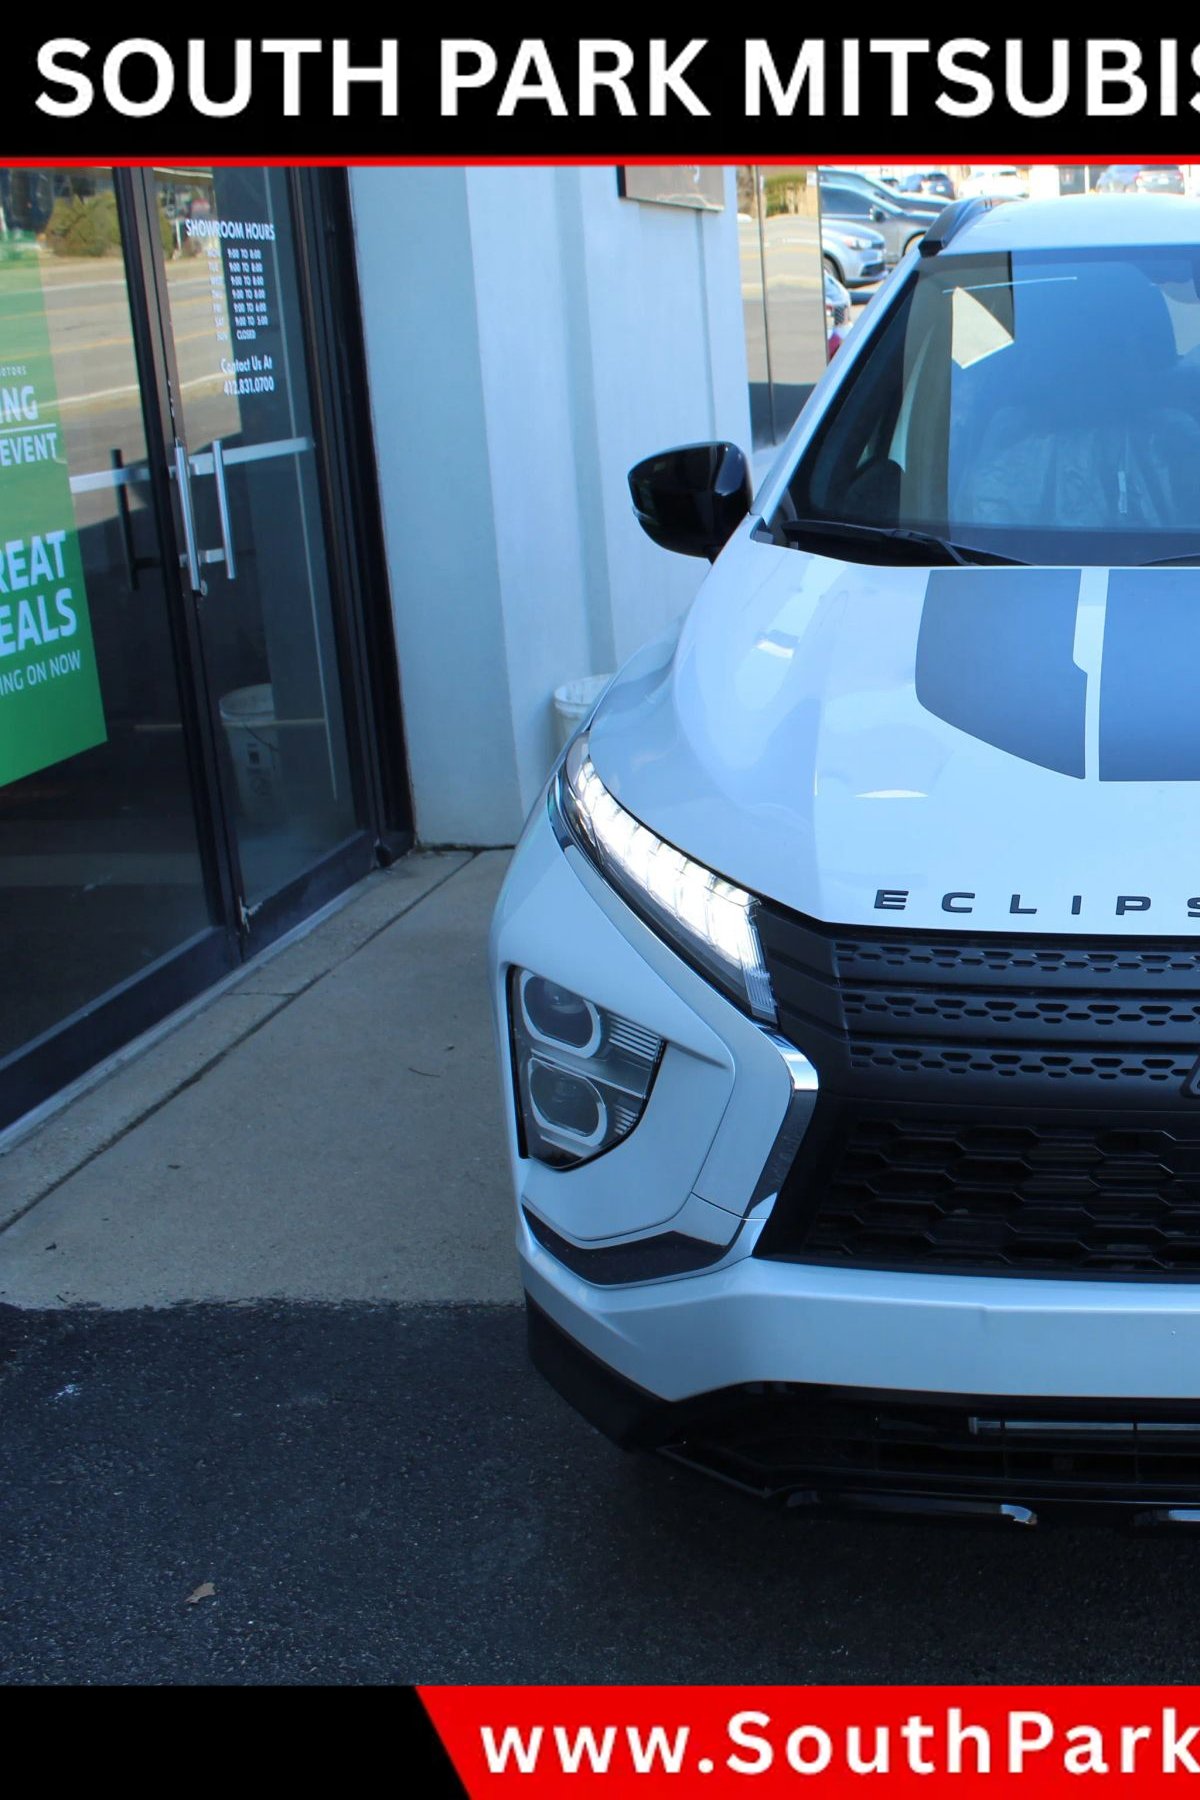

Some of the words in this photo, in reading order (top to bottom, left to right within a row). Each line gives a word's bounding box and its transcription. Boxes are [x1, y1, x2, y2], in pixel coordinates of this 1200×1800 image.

[185, 219, 244, 239] SHOWROOM
[244, 222, 276, 241] HOURS
[220, 358, 251, 375] Contact
[251, 355, 262, 371] Us
[263, 354, 273, 370] At
[223, 375, 275, 396] 412.831.0700
[27, 661, 47, 686] ON
[49, 650, 81, 679] NOW
